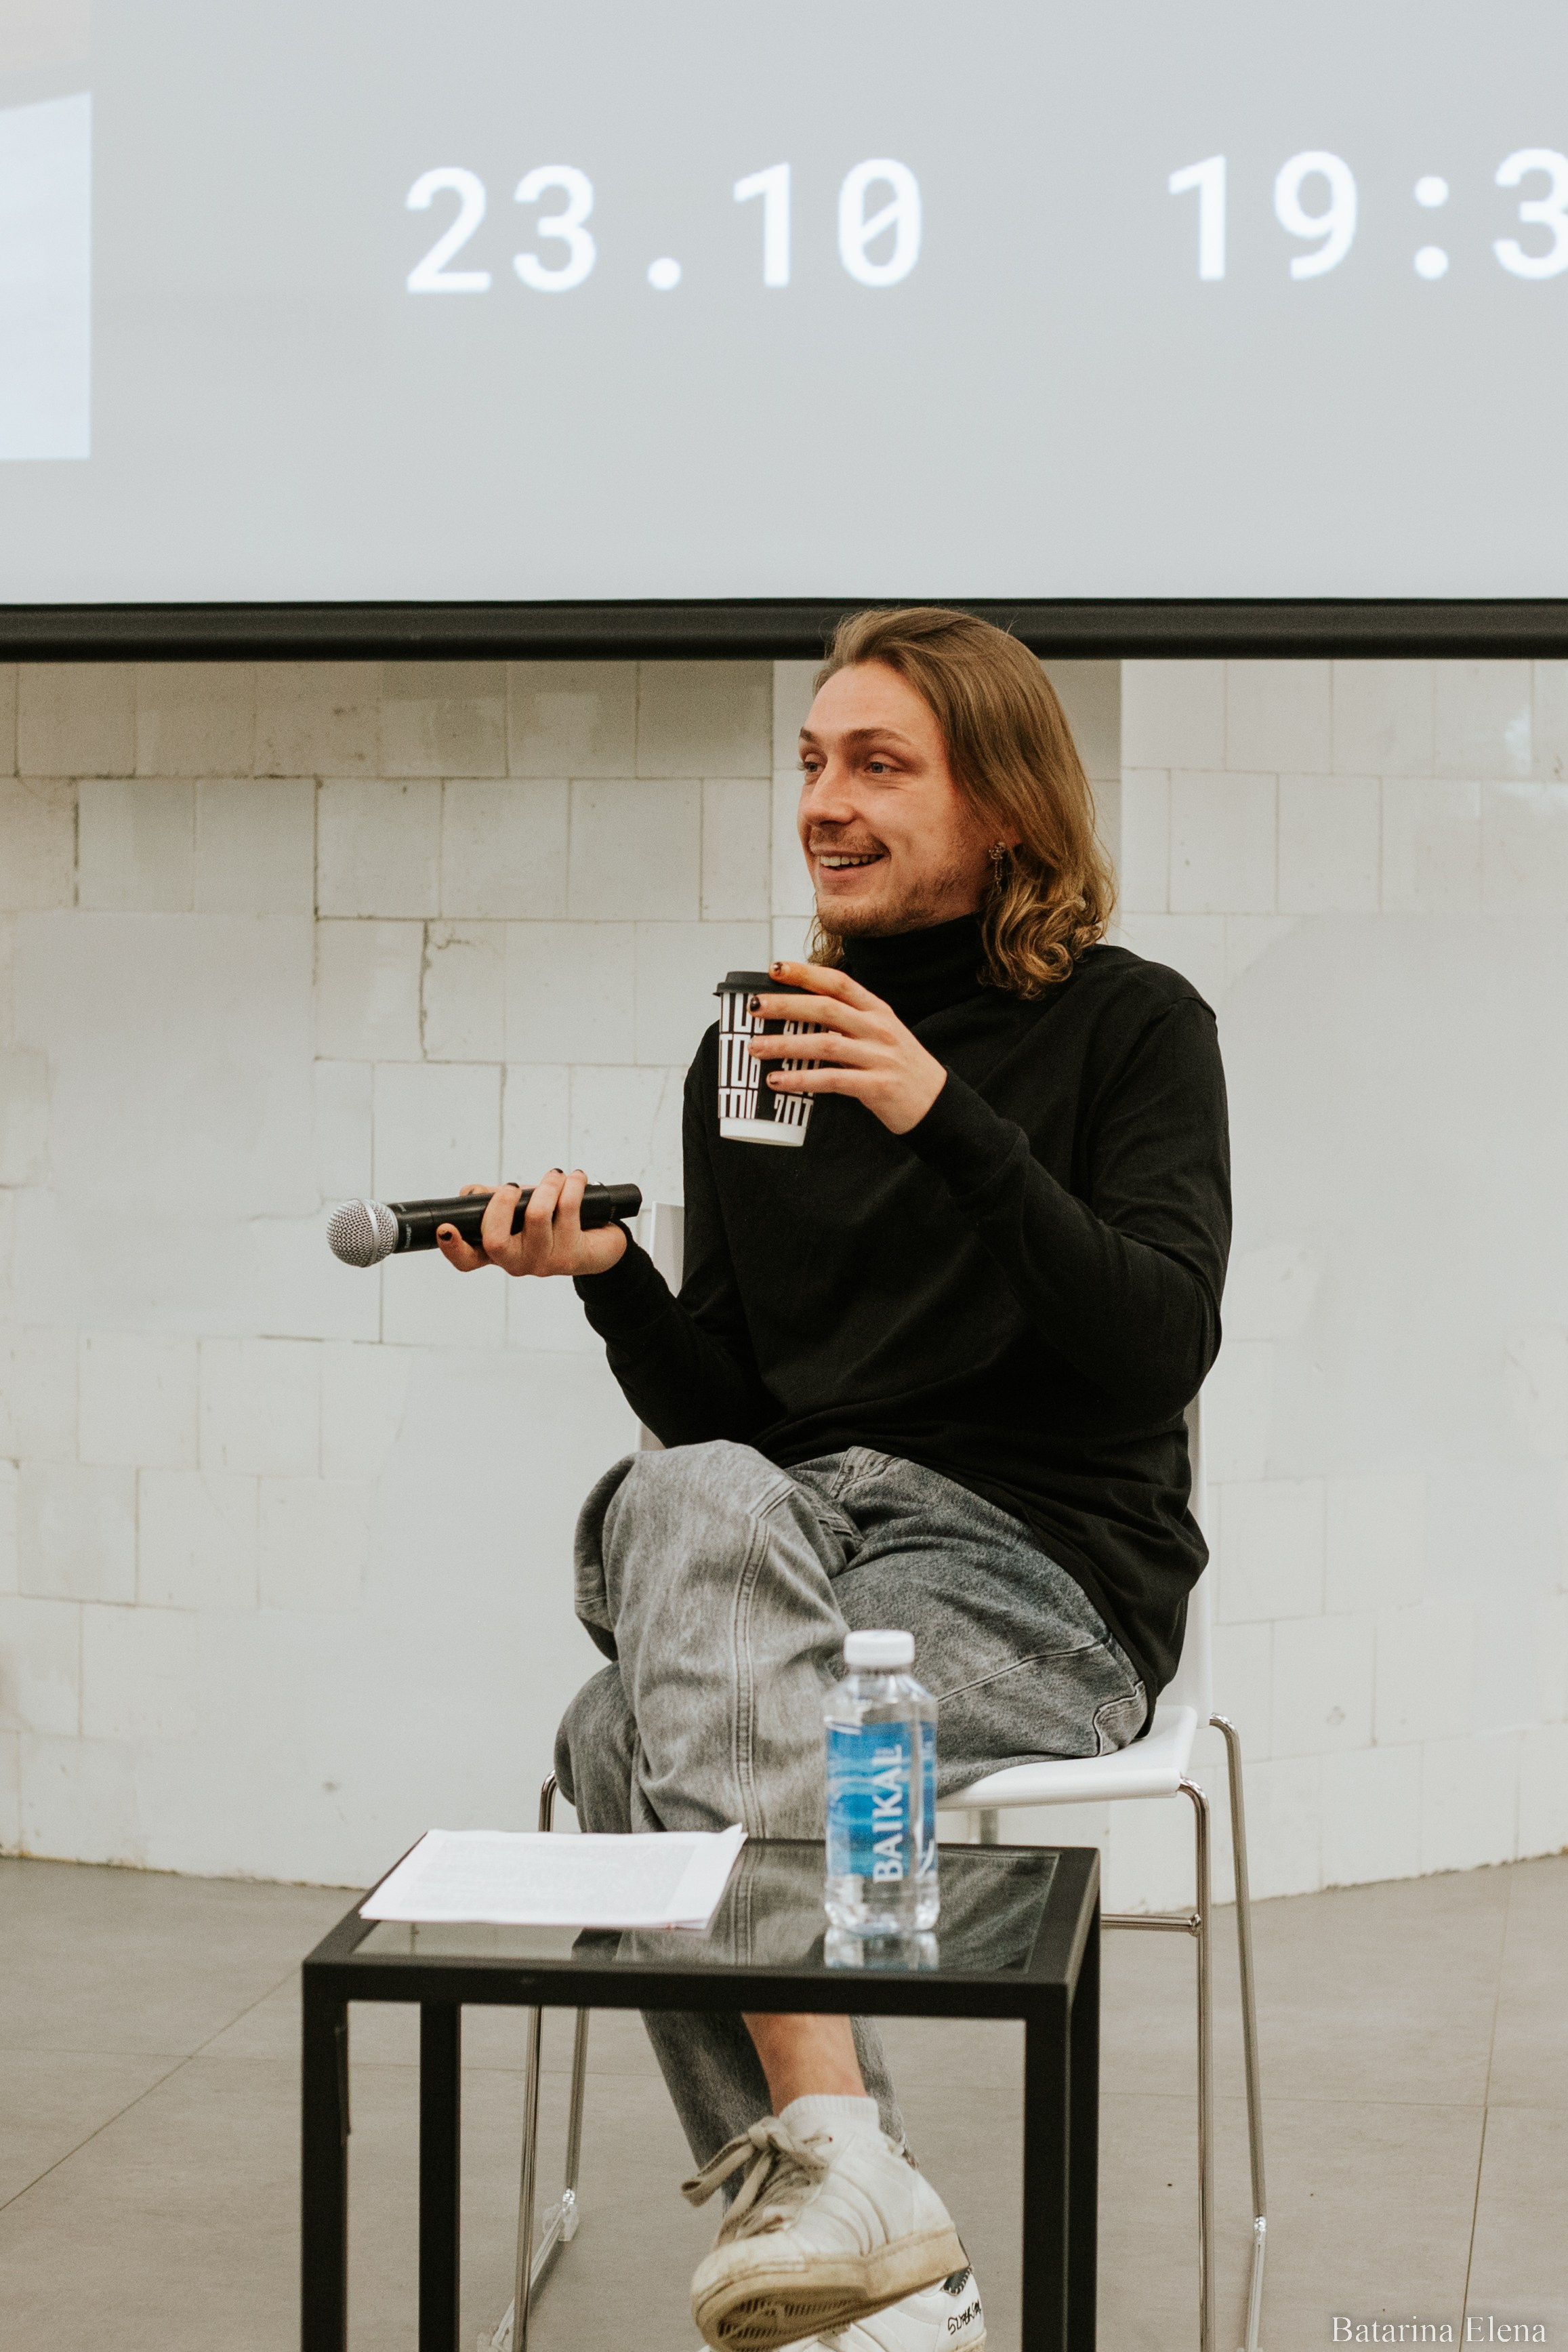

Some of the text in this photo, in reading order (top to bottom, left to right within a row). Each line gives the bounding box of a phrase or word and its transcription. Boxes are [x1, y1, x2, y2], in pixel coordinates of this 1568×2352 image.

[405, 147, 1568, 293] 23.10 19:3
[871, 1744, 903, 1884] BAIKAL
